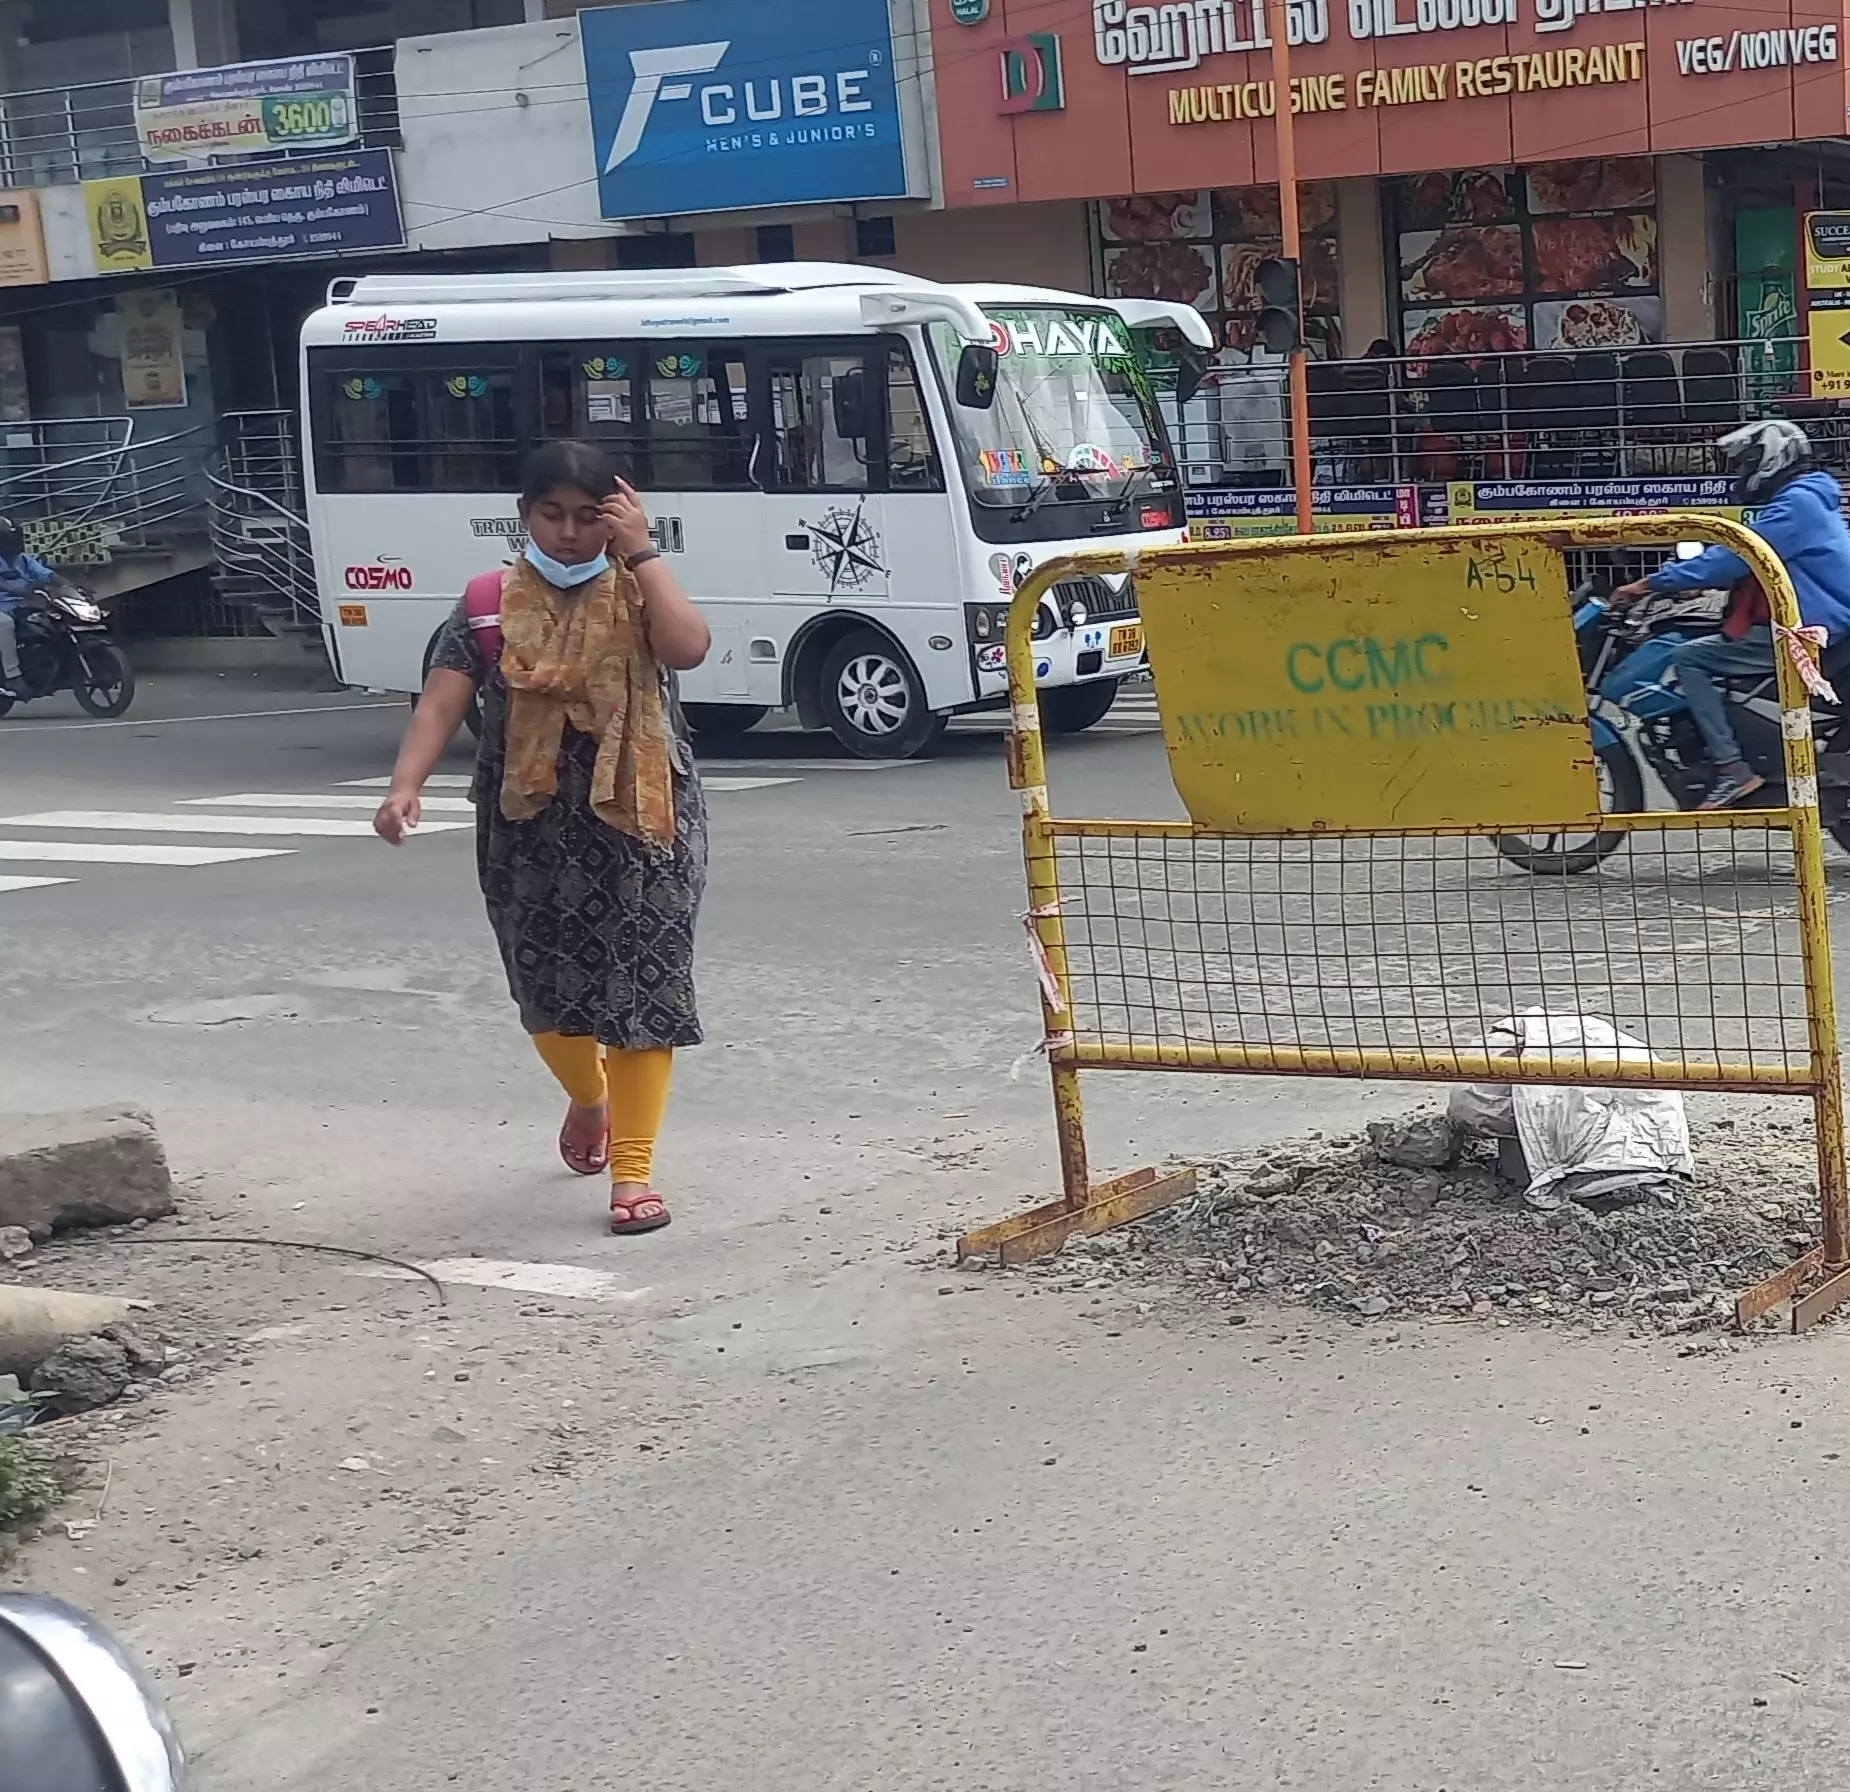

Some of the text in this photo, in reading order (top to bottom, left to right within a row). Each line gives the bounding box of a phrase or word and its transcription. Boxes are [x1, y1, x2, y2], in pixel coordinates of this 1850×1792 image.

[1169, 41, 1646, 125] MULTICUSINE FAMILY RESTAURANT
[273, 101, 330, 135] 3600
[706, 123, 876, 152] MEN'S & JUNIOR'S
[1751, 300, 1792, 337] Sprite
[1821, 380, 1841, 390] +91
[1207, 492, 1255, 506] பரஸ்பர
[1478, 479, 1729, 500] கும்பகோணம் பரஸ்பர ஸகாய நிதி
[345, 566, 413, 590] COSMO
[1286, 633, 1449, 693] CCMC
